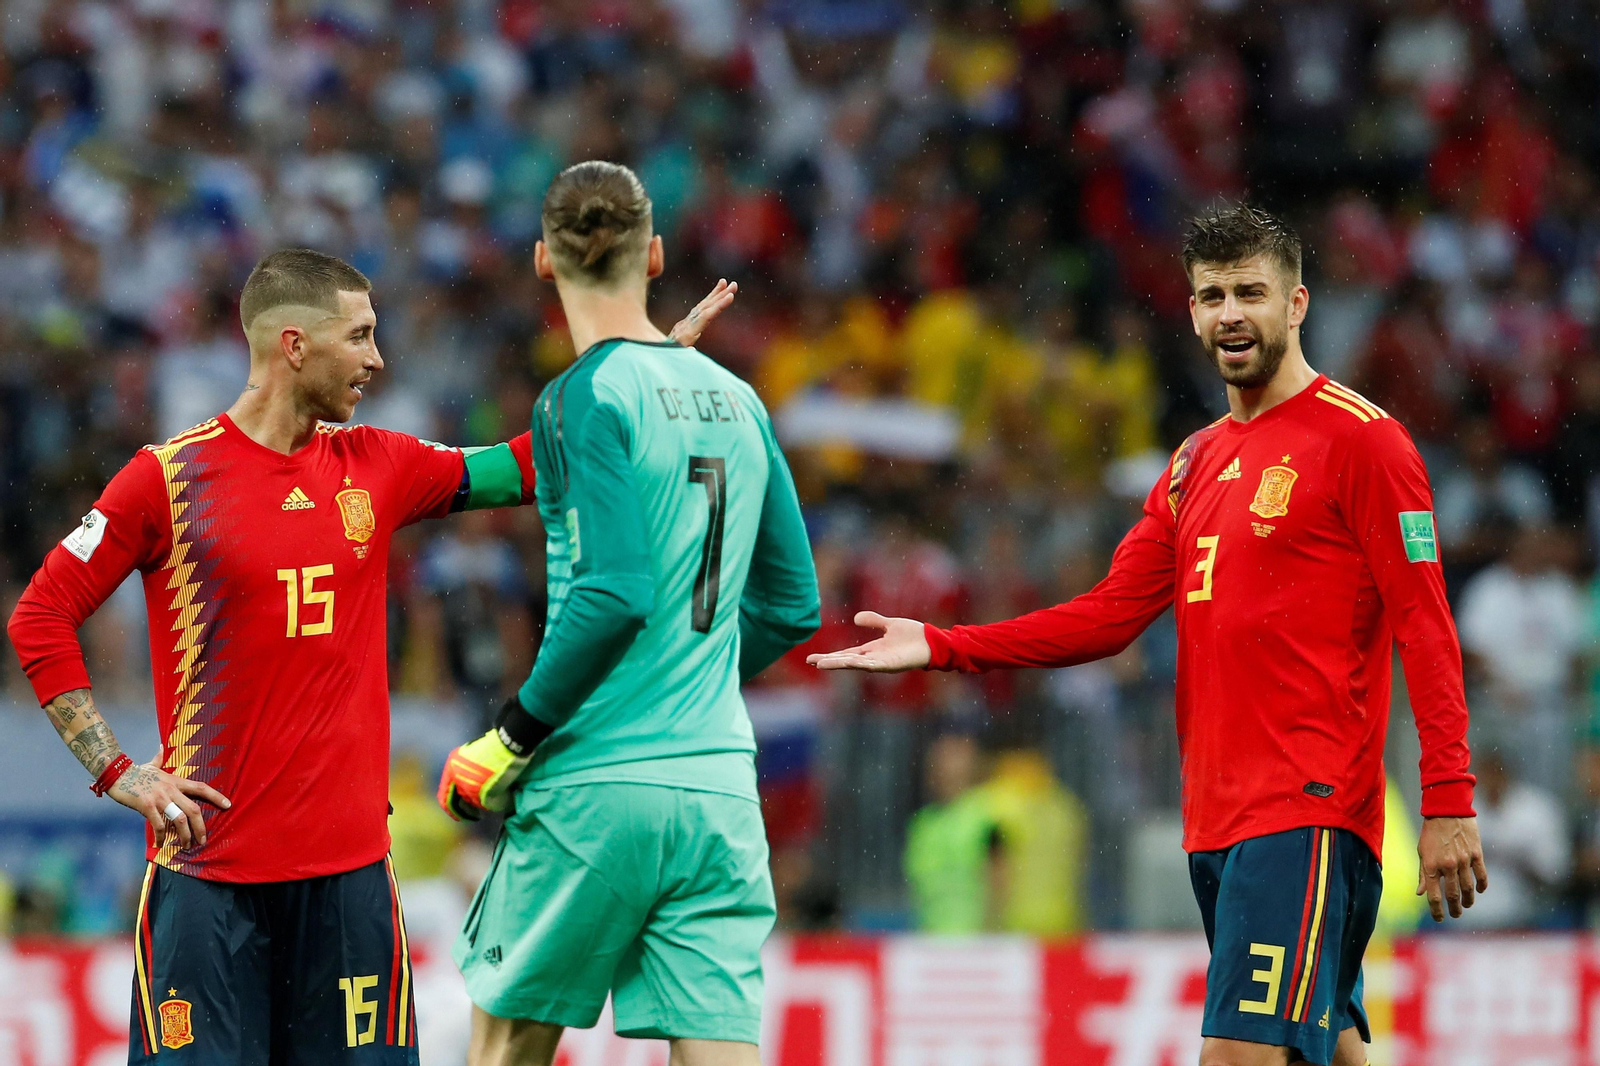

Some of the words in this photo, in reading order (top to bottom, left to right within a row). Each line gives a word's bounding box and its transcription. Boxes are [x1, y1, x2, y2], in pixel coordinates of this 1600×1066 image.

[657, 388, 690, 421] DE
[281, 501, 316, 511] adidas
[1217, 471, 1242, 482] adidas
[688, 455, 726, 633] 1
[1187, 535, 1220, 604] 3
[277, 563, 334, 638] 15
[338, 974, 379, 1048] 15
[1238, 942, 1286, 1016] 3
